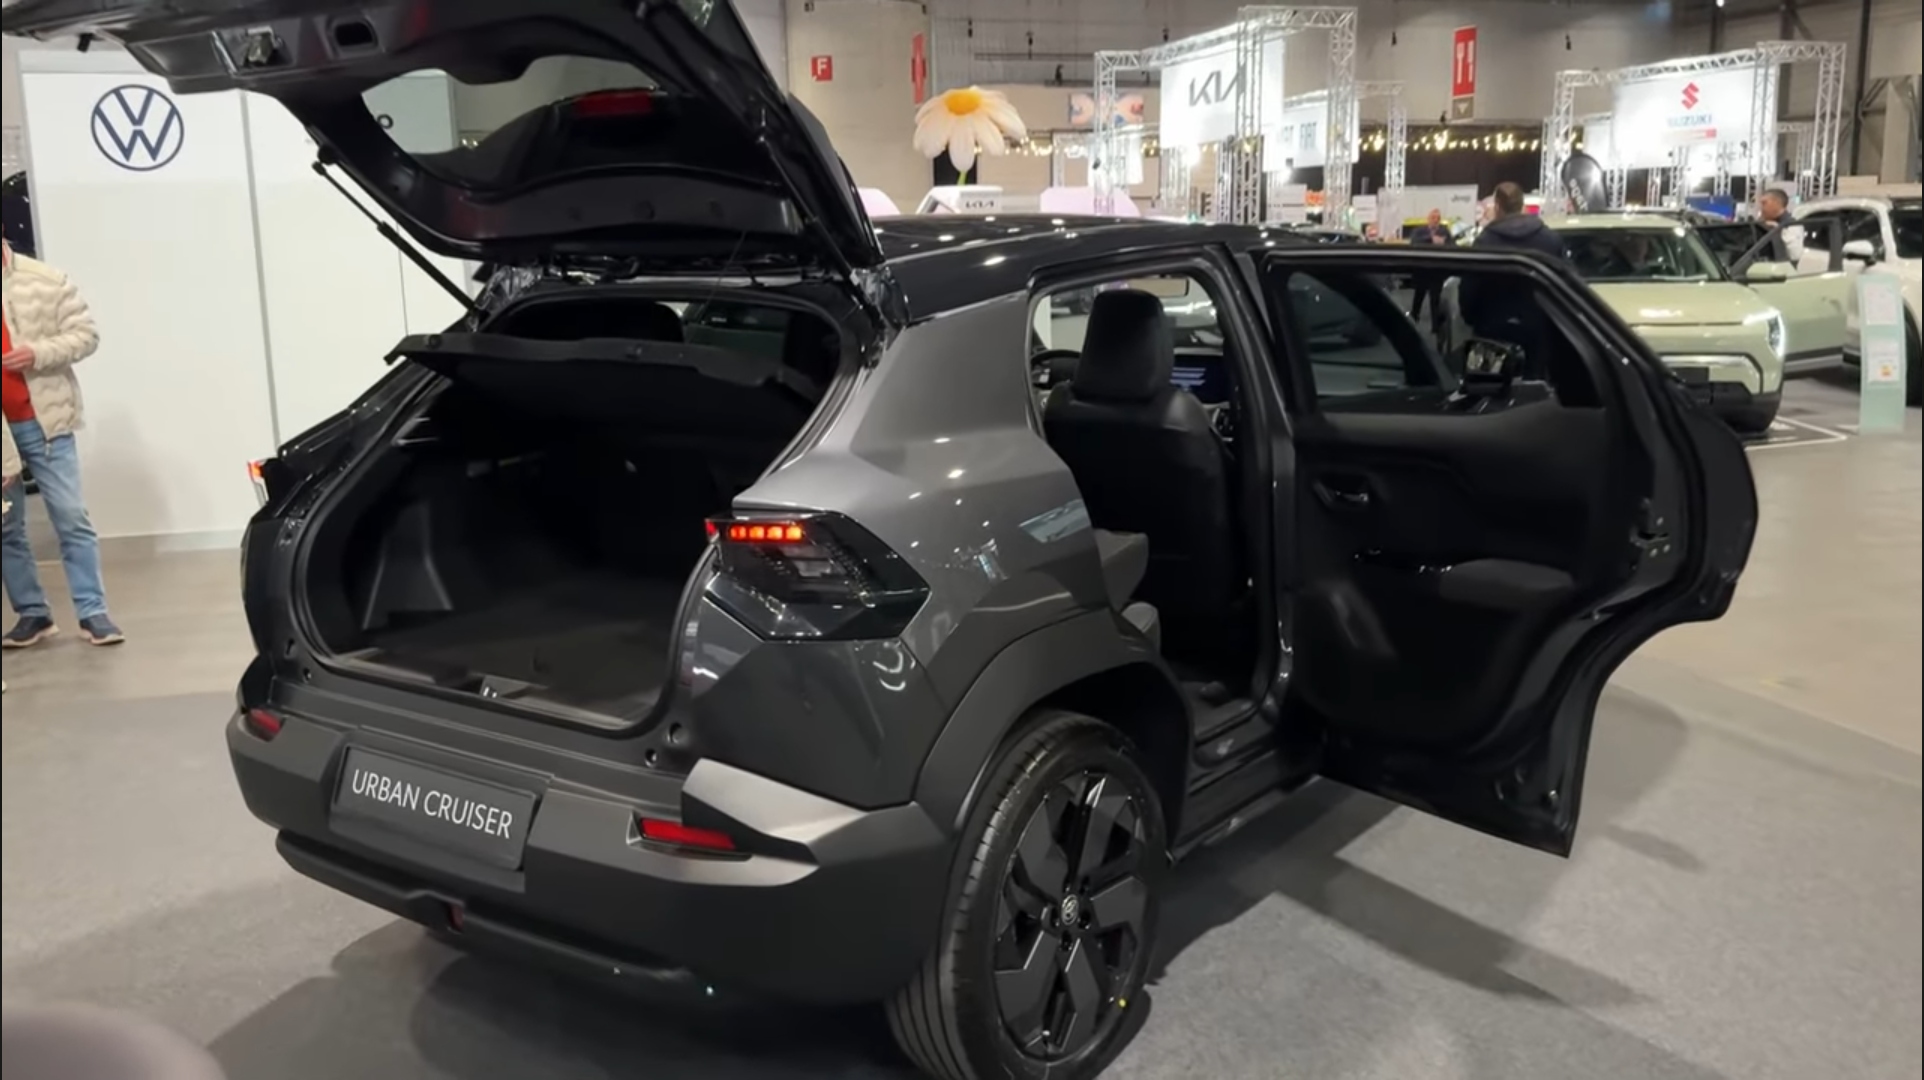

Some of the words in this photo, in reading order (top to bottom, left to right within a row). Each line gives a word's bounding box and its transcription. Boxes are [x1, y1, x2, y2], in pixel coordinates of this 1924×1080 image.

[817, 57, 828, 76] F
[352, 769, 421, 811] URBAN
[424, 790, 513, 839] CRUISER
